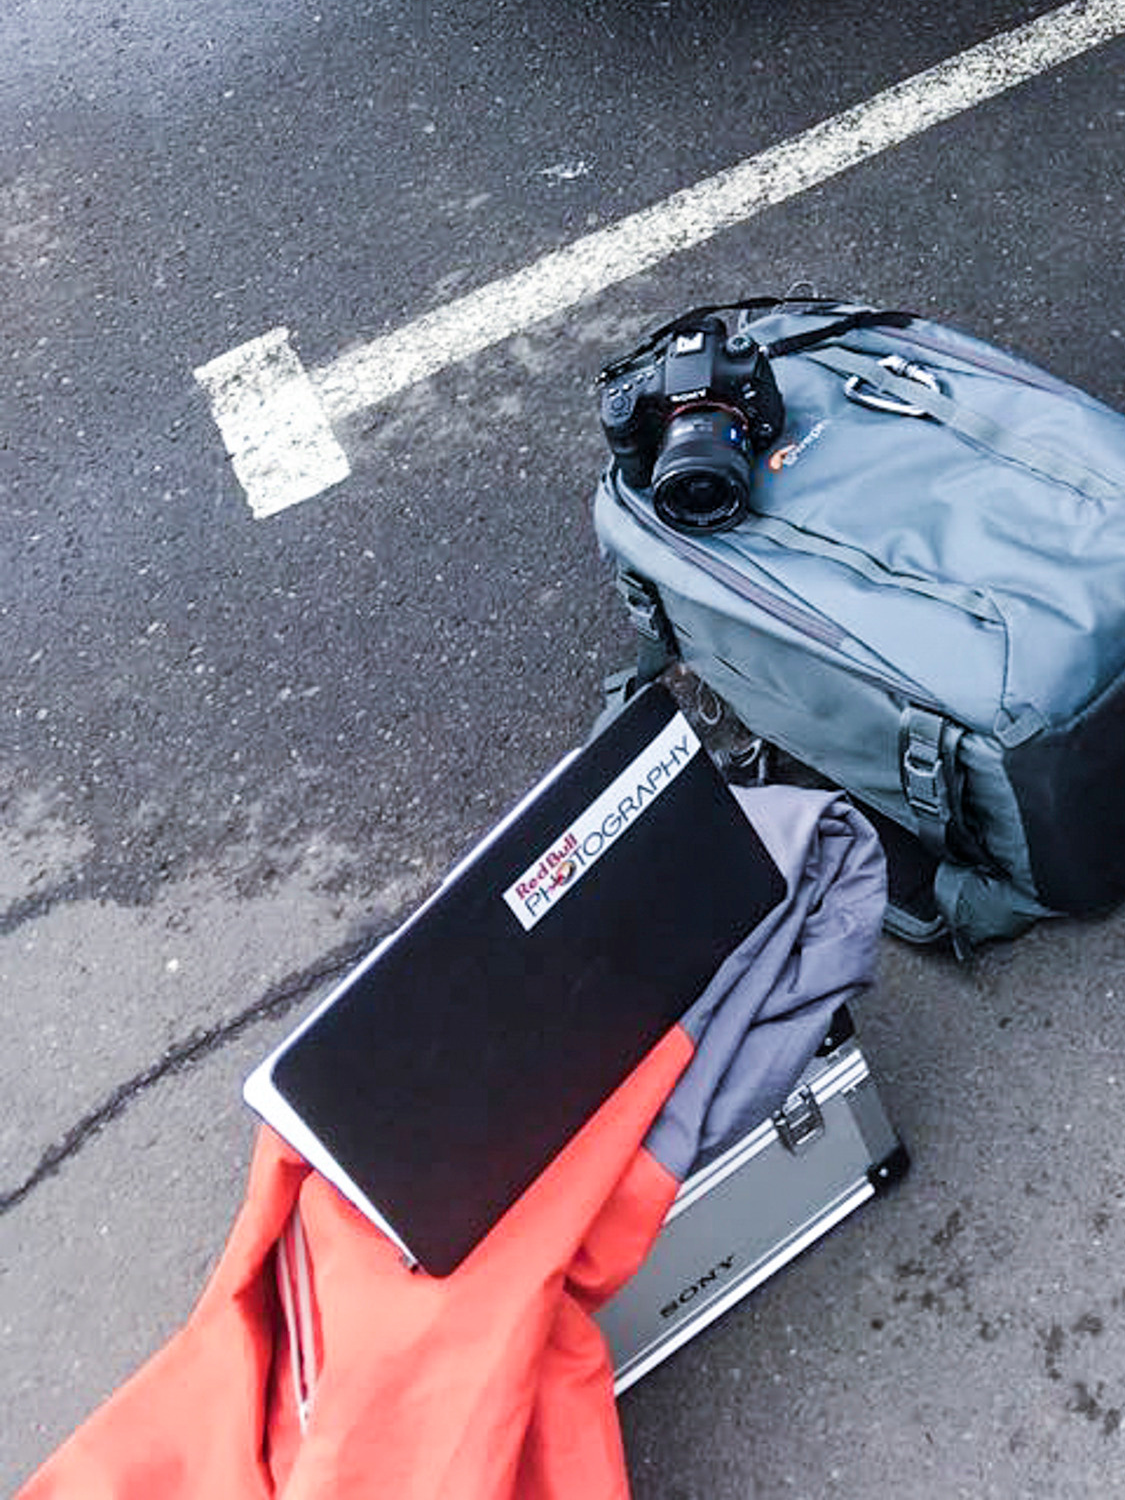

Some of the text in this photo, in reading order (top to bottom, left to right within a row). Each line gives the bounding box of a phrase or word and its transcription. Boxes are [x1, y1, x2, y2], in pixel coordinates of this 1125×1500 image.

[515, 833, 578, 900] Red Bull
[660, 1255, 735, 1318] SONY
